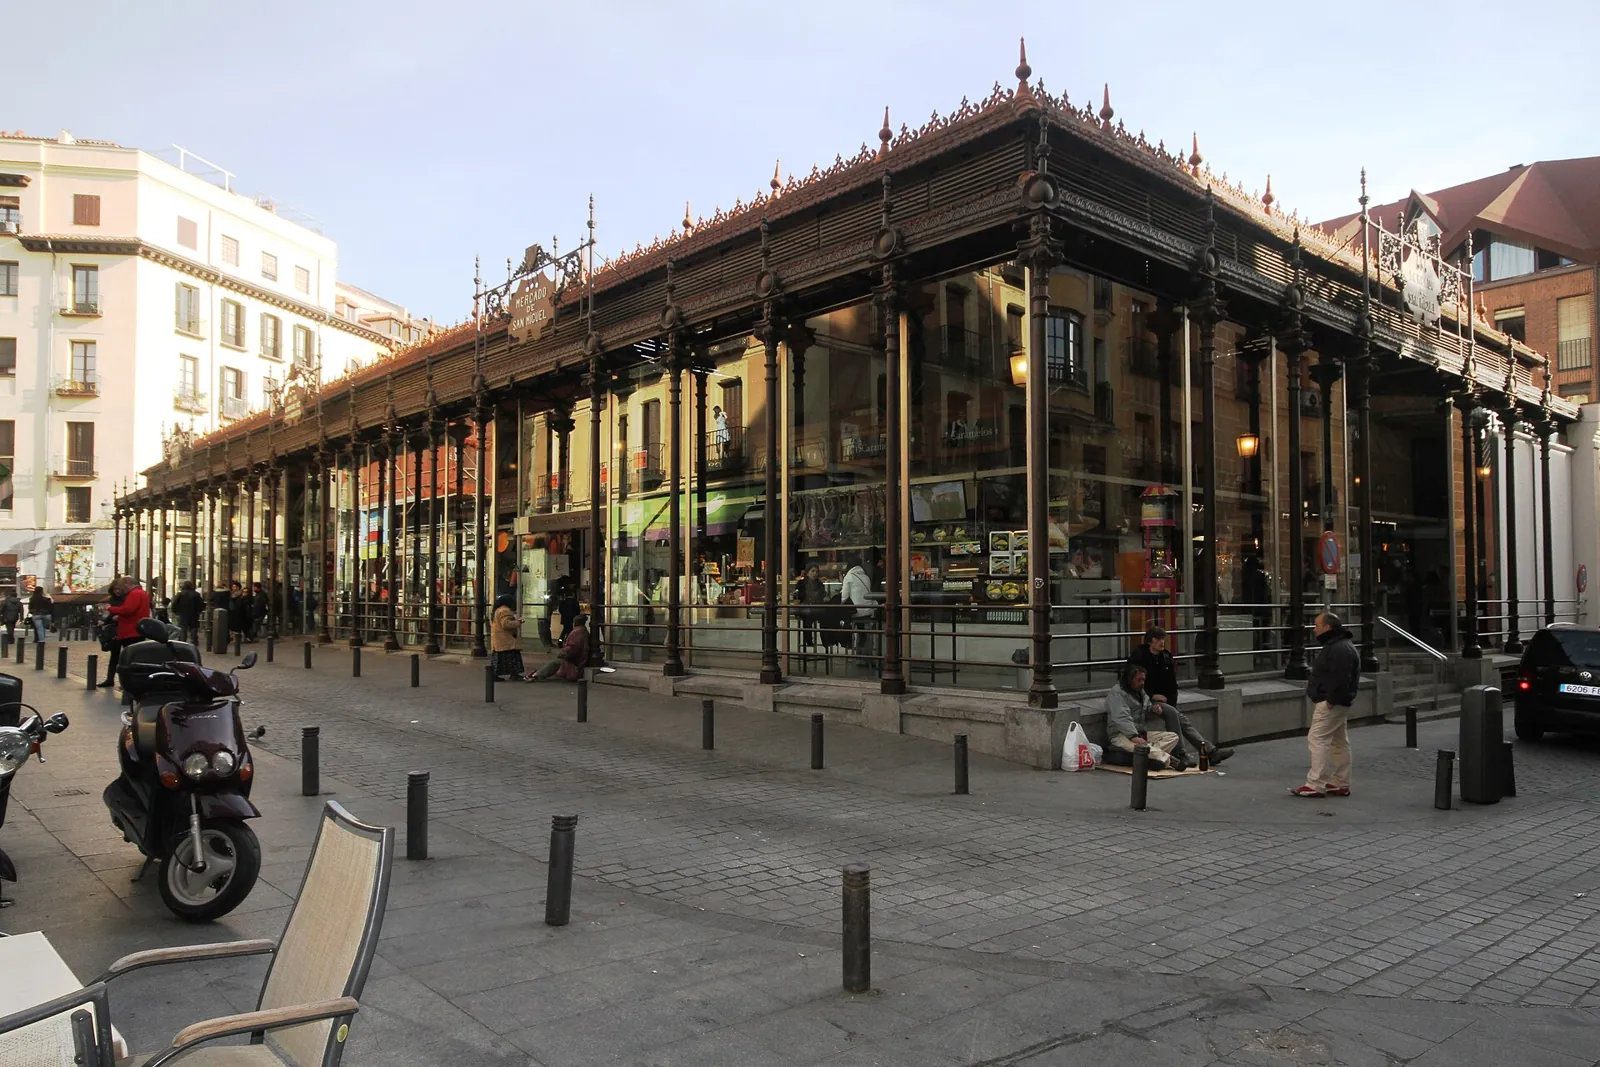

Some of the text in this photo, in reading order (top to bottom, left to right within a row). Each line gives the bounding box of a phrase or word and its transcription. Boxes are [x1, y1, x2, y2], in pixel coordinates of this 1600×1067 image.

[515, 286, 548, 309] MERCADO
[526, 303, 535, 314] DE
[512, 309, 547, 331] SAN MIGUEL
[1566, 684, 1588, 694] 6206
